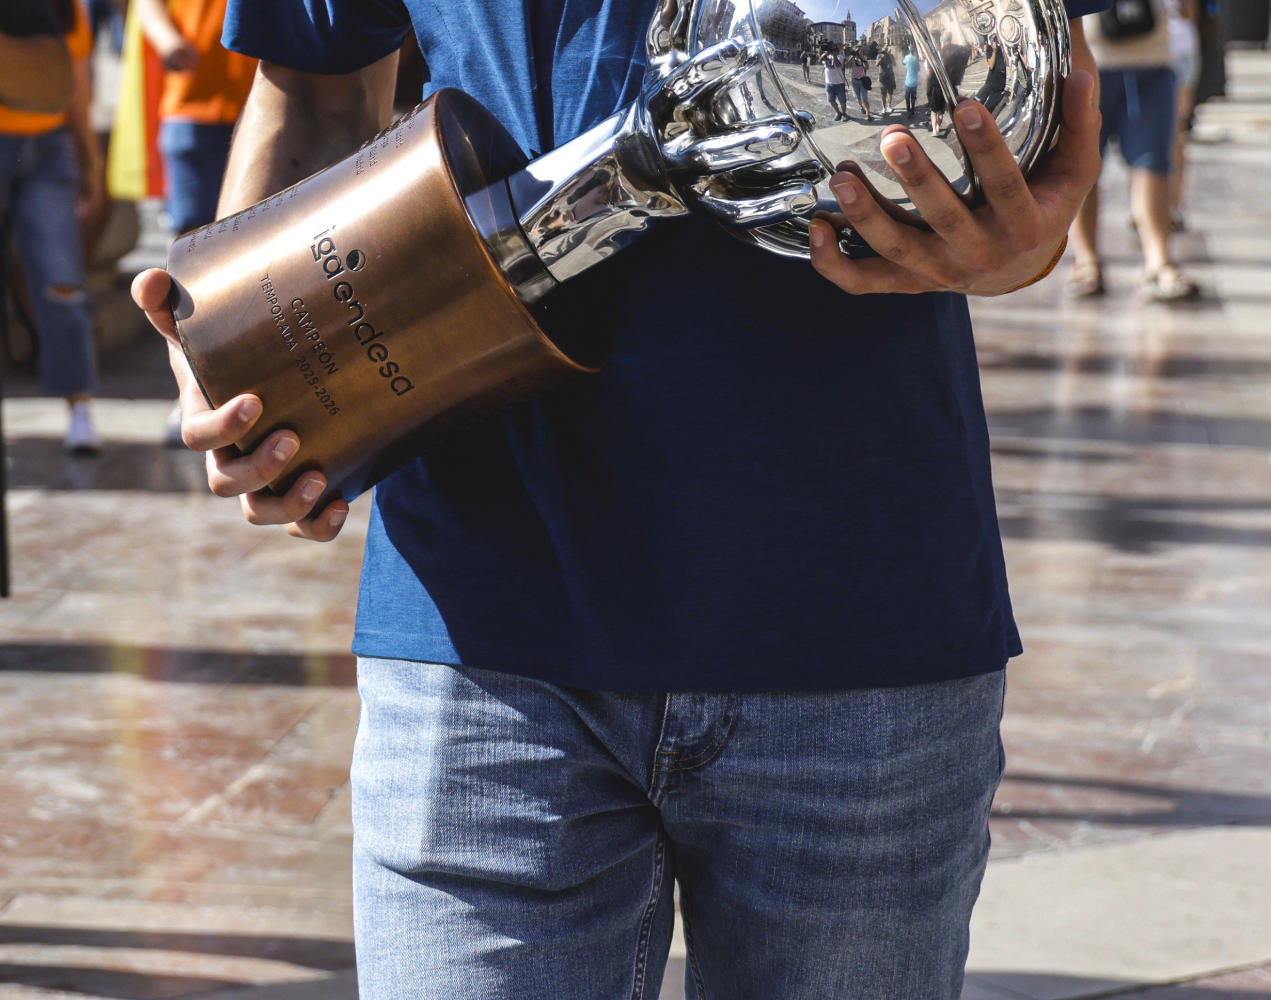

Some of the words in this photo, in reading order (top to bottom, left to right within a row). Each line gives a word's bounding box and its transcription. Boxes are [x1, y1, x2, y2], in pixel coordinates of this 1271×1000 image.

[260, 273, 299, 352] TEMPORADA
[295, 355, 341, 416] 2025-2026
[290, 297, 340, 376] CAMPEÓN
[333, 280, 416, 397] endesa
